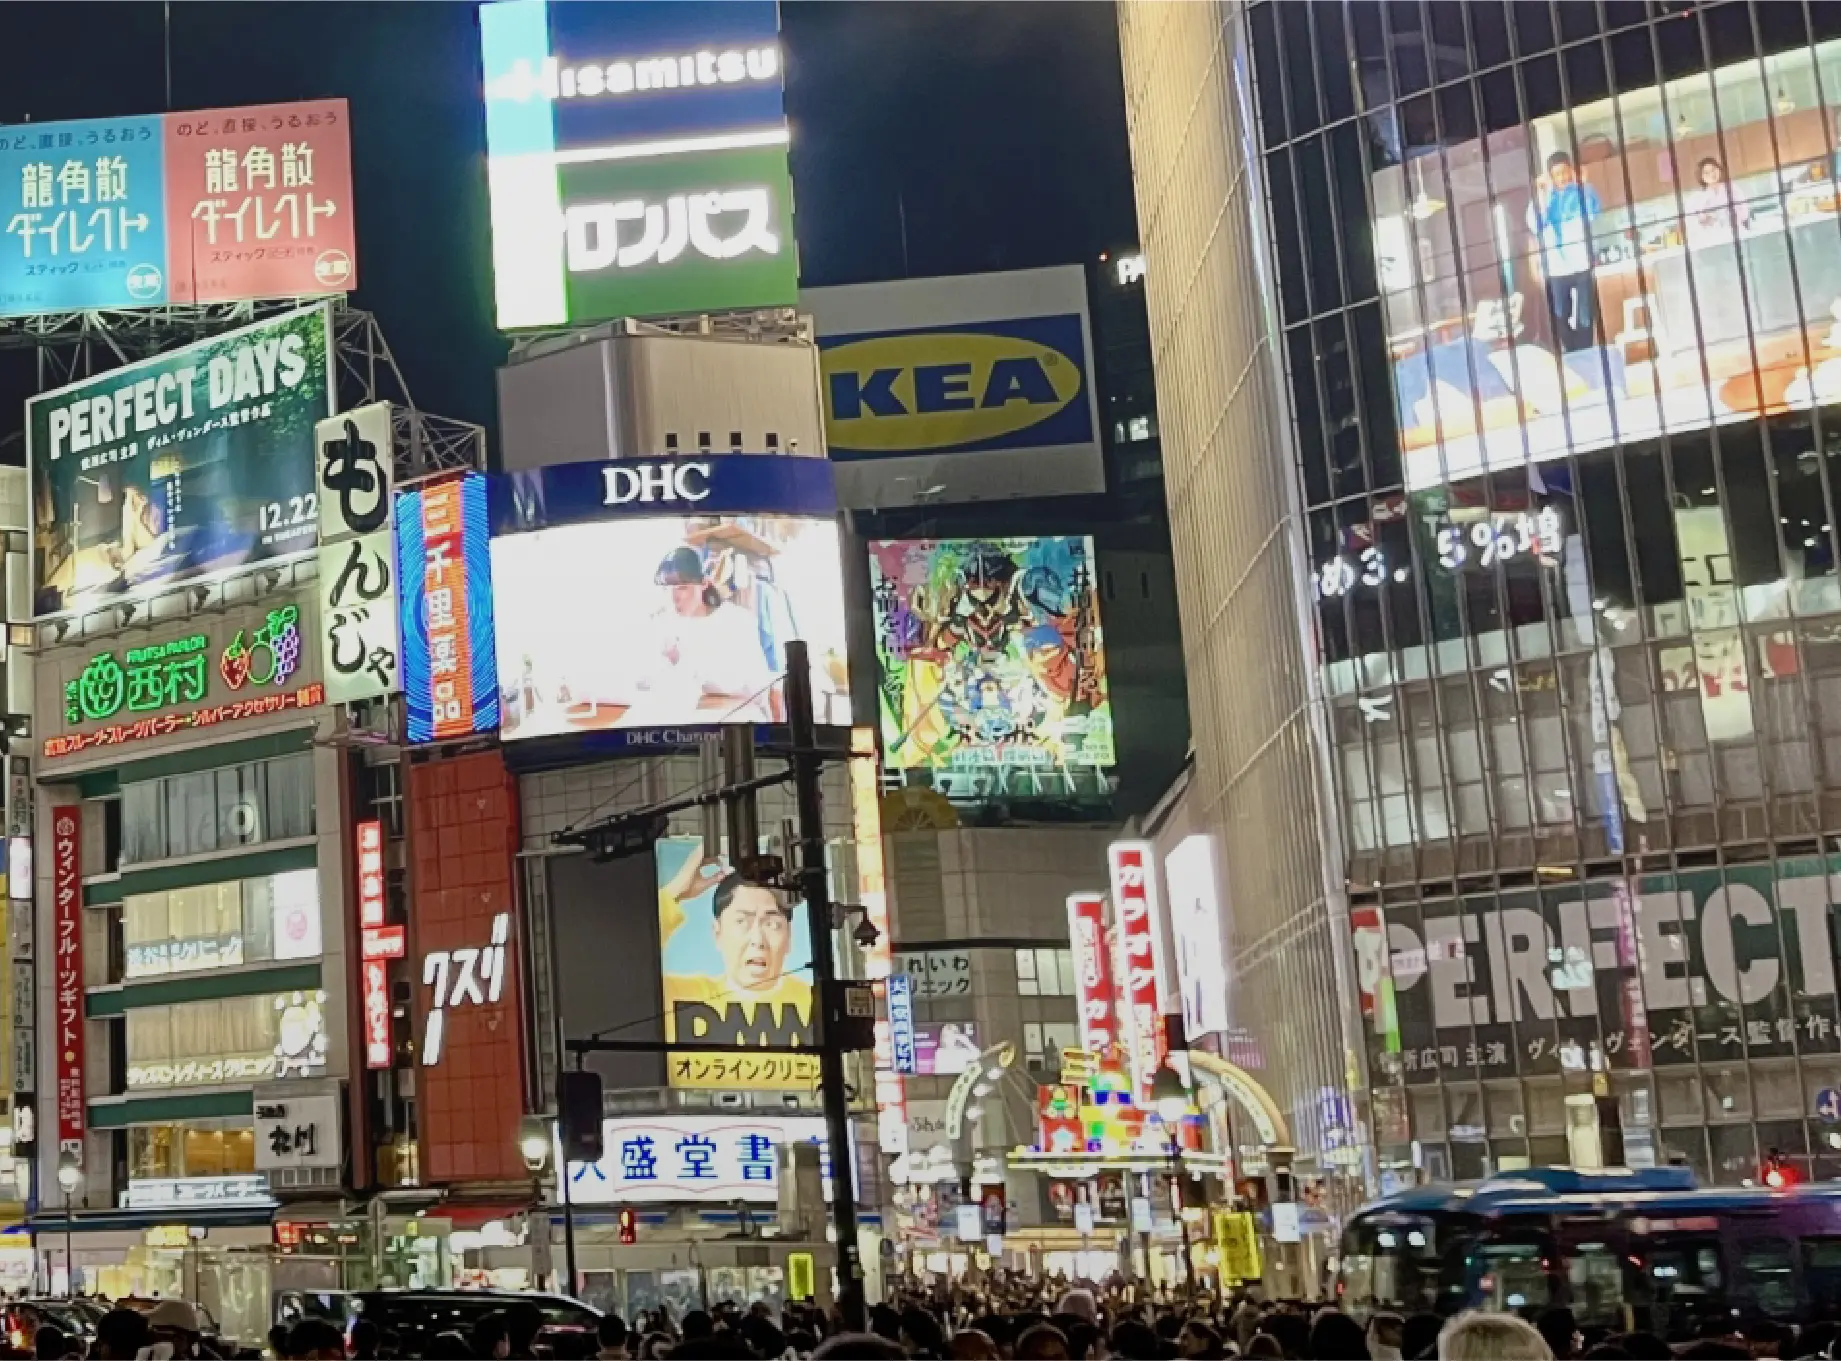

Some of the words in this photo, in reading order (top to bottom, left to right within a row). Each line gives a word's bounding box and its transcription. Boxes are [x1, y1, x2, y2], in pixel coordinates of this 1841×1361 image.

[21, 154, 128, 208] 龍角散
[205, 141, 314, 194] 龍角散
[6, 206, 150, 258] ダイレクト
[191, 192, 338, 245] ダイレクト
[560, 188, 779, 272] ロンパス
[48, 365, 198, 461] PERFECT
[208, 334, 307, 409] DAYS
[830, 357, 1061, 420] KEA
[602, 463, 712, 505] DHC
[259, 492, 319, 532] 12.22
[322, 409, 397, 688] もんじゃ
[424, 492, 462, 724] 三千里薬品
[126, 653, 206, 712] 西村
[626, 730, 660, 745] DHC
[662, 729, 726, 745] Channel
[56, 838, 80, 1048] ウィンターフルーツギフト
[1360, 876, 1841, 1028] PERFECT
[910, 977, 970, 995] リニック
[676, 1056, 822, 1083] オンラインクリニ
[572, 1133, 844, 1181] 盛堂書
